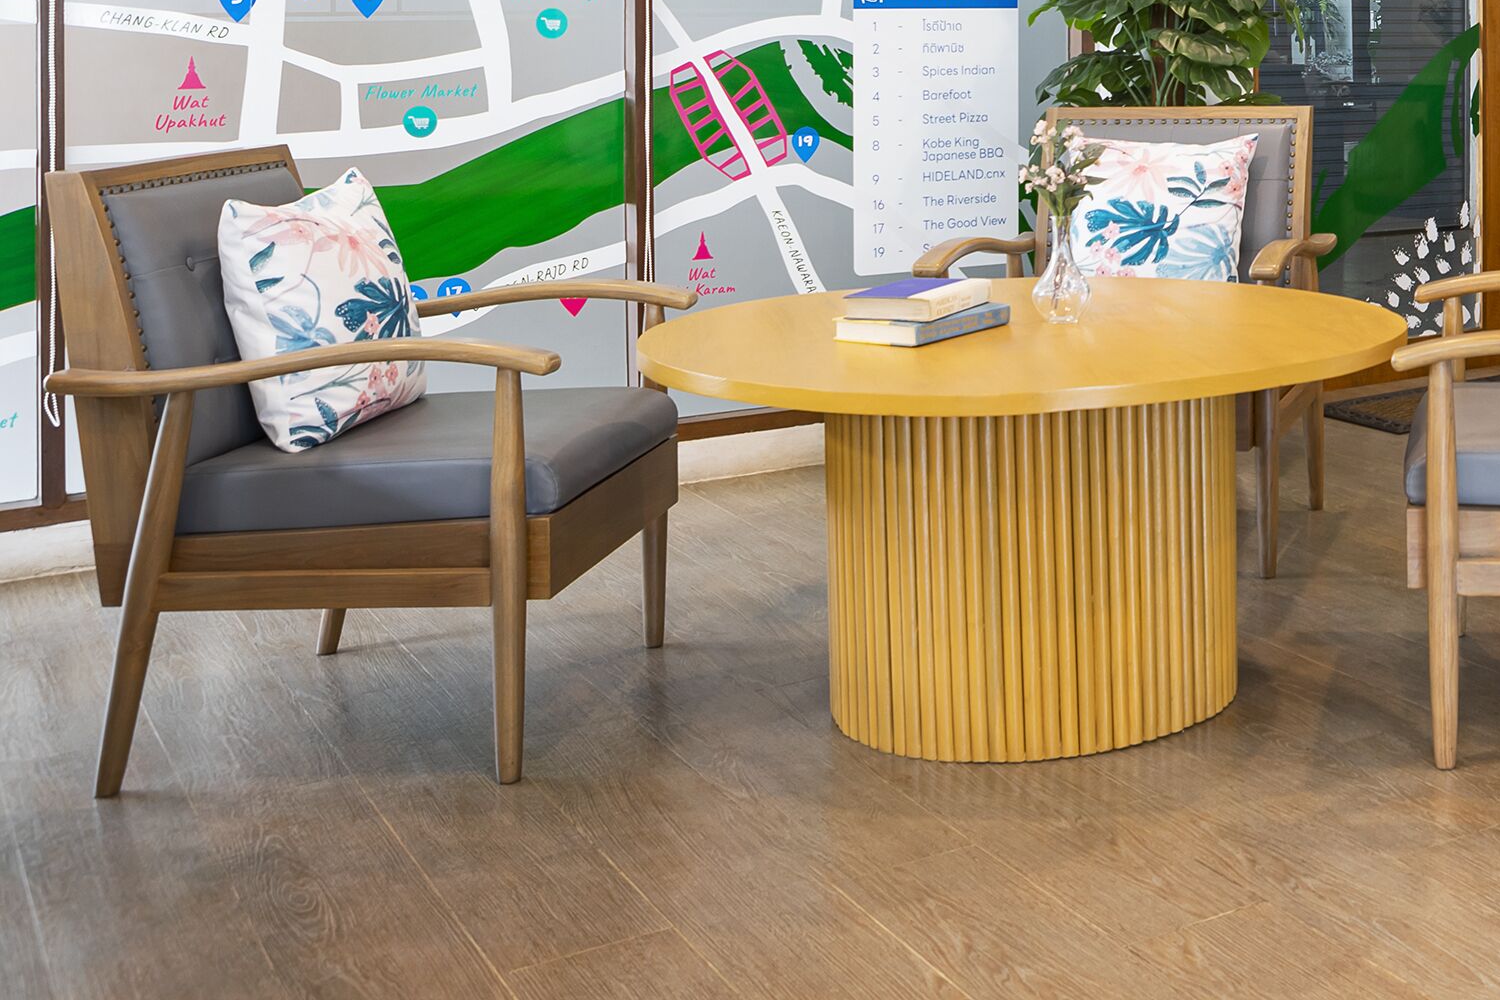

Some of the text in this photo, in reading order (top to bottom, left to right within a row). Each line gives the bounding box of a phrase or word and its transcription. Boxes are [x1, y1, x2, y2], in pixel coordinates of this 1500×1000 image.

[100, 10, 230, 40] CHANG-KLAN RD
[872, 43, 880, 55] 2
[872, 64, 995, 79] 3 Spices Indian
[365, 83, 478, 100] Flower Market
[872, 89, 972, 101] 4 Barefoot
[173, 95, 210, 110] Wat
[155, 113, 226, 133] Upakhut
[872, 112, 989, 126] 5 Street Pizza
[798, 135, 813, 147] 19
[872, 137, 980, 151] 8 Kobe King
[922, 147, 1004, 163] Japanese BBQ
[872, 169, 1006, 184] 9 HIDELAND.cnx
[873, 193, 997, 210] 16 The Riverside
[873, 215, 1007, 234] 17 The Good View
[873, 246, 885, 258] 19
[572, 257, 589, 271] RD
[688, 267, 716, 281] Wat
[695, 283, 736, 296] Karam
